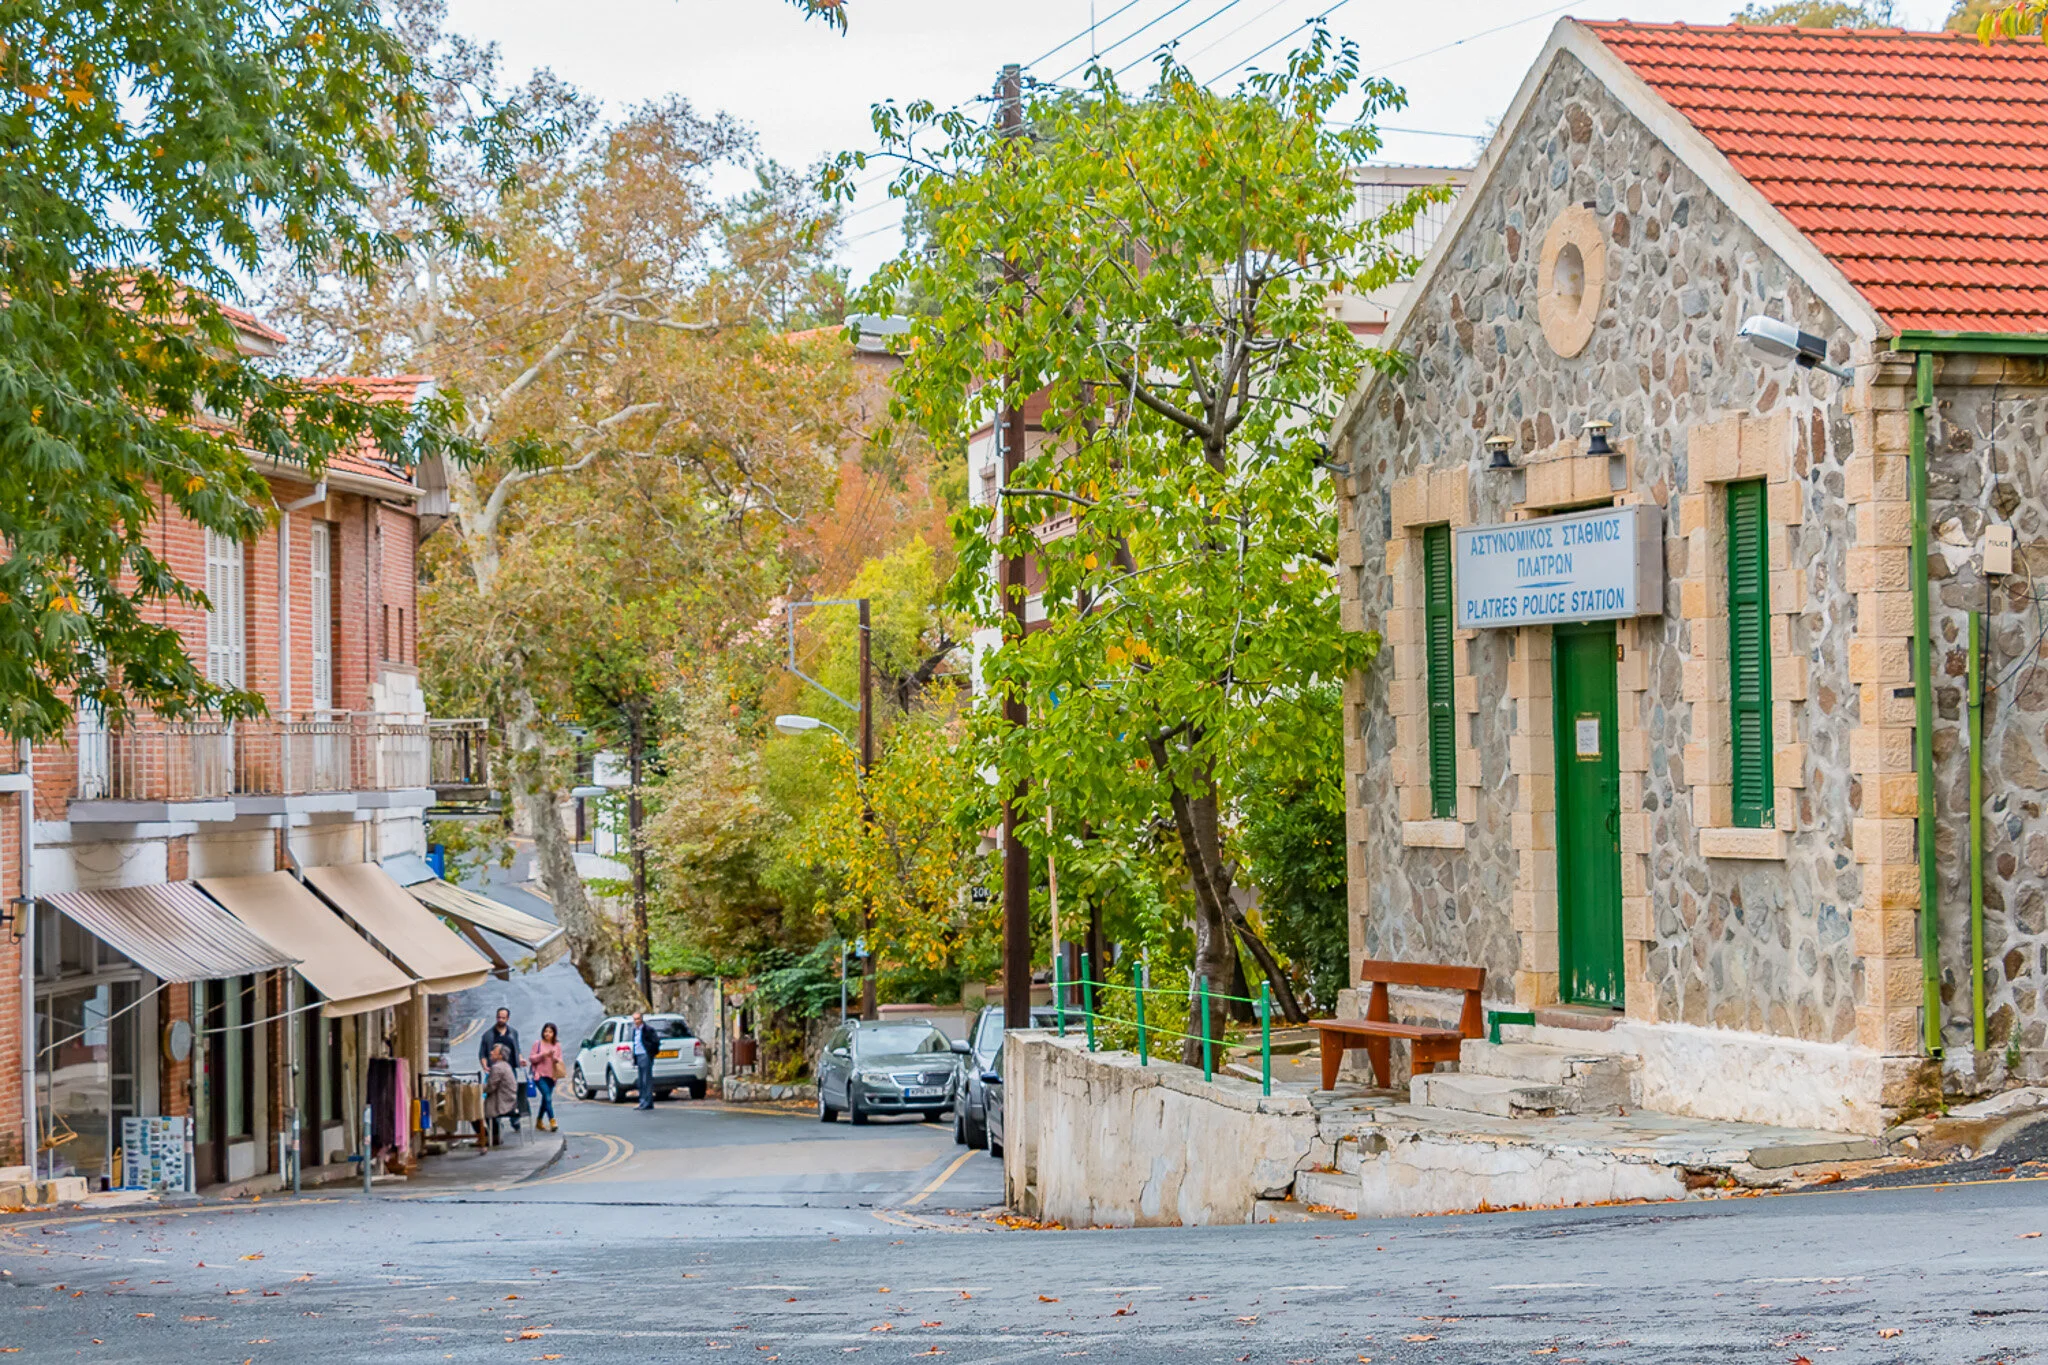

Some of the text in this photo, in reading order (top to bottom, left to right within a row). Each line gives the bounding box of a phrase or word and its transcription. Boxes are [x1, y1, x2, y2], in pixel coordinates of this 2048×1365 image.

[1470, 519, 1621, 556] ΑΣΤΥΝΟΜΙΚΟΣ ΣΤΑΘΜΟΣ
[1517, 552, 1573, 578] ΠΛΑΤΡΩΝ
[1467, 587, 1625, 620] PLATRES POLICE STATION
